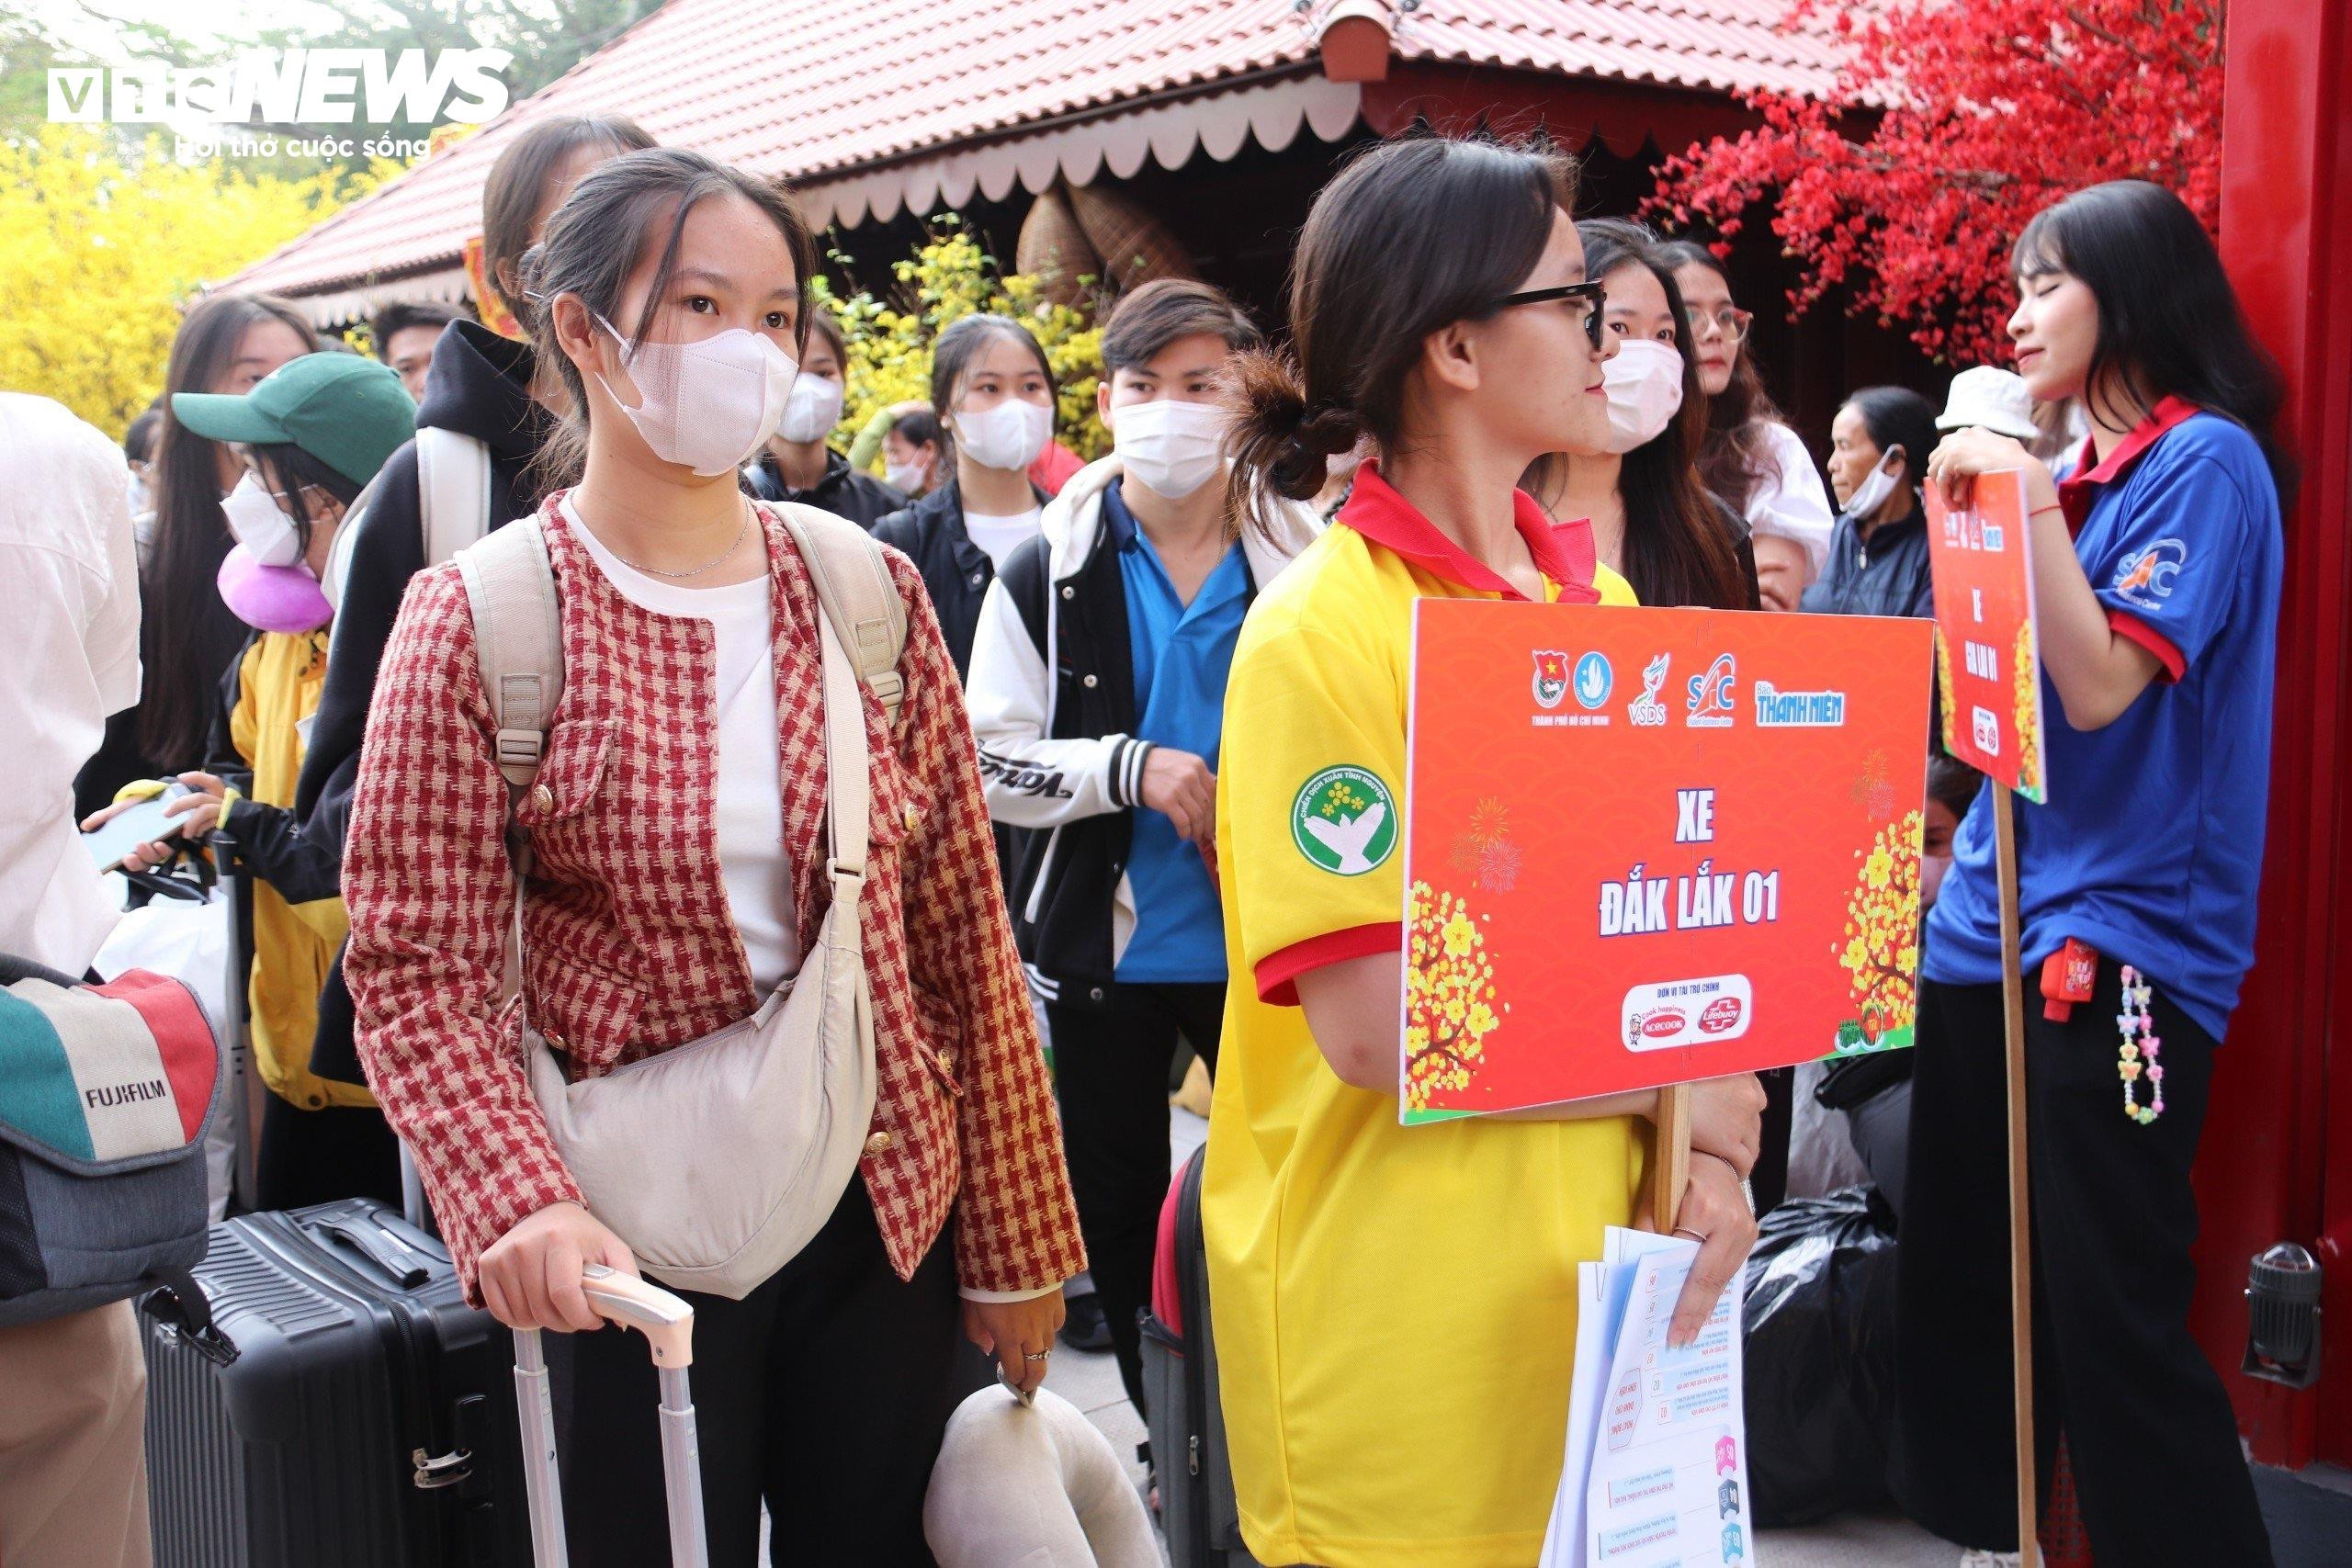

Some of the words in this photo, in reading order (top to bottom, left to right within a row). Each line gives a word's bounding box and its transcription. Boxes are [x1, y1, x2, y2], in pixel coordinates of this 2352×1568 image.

[1630, 706, 1664, 723] VSDS
[1758, 695, 1807, 723] THANH
[1809, 694, 1842, 723] NIÊN
[1309, 780, 1324, 796] DỊCH
[1324, 772, 1343, 784] XUÂN
[1344, 771, 1362, 781] TÌNH
[1675, 788, 1714, 843] XE
[1599, 863, 1669, 937] ĐẮK
[1677, 858, 1736, 930] LẮK
[1742, 869, 1779, 924] 01
[1657, 987, 1669, 998] ĐƠN
[1657, 1005, 1686, 1015] happiness
[1702, 1009, 1739, 1021] Lifebuoy
[85, 1079, 166, 1109] FUJIFILM
